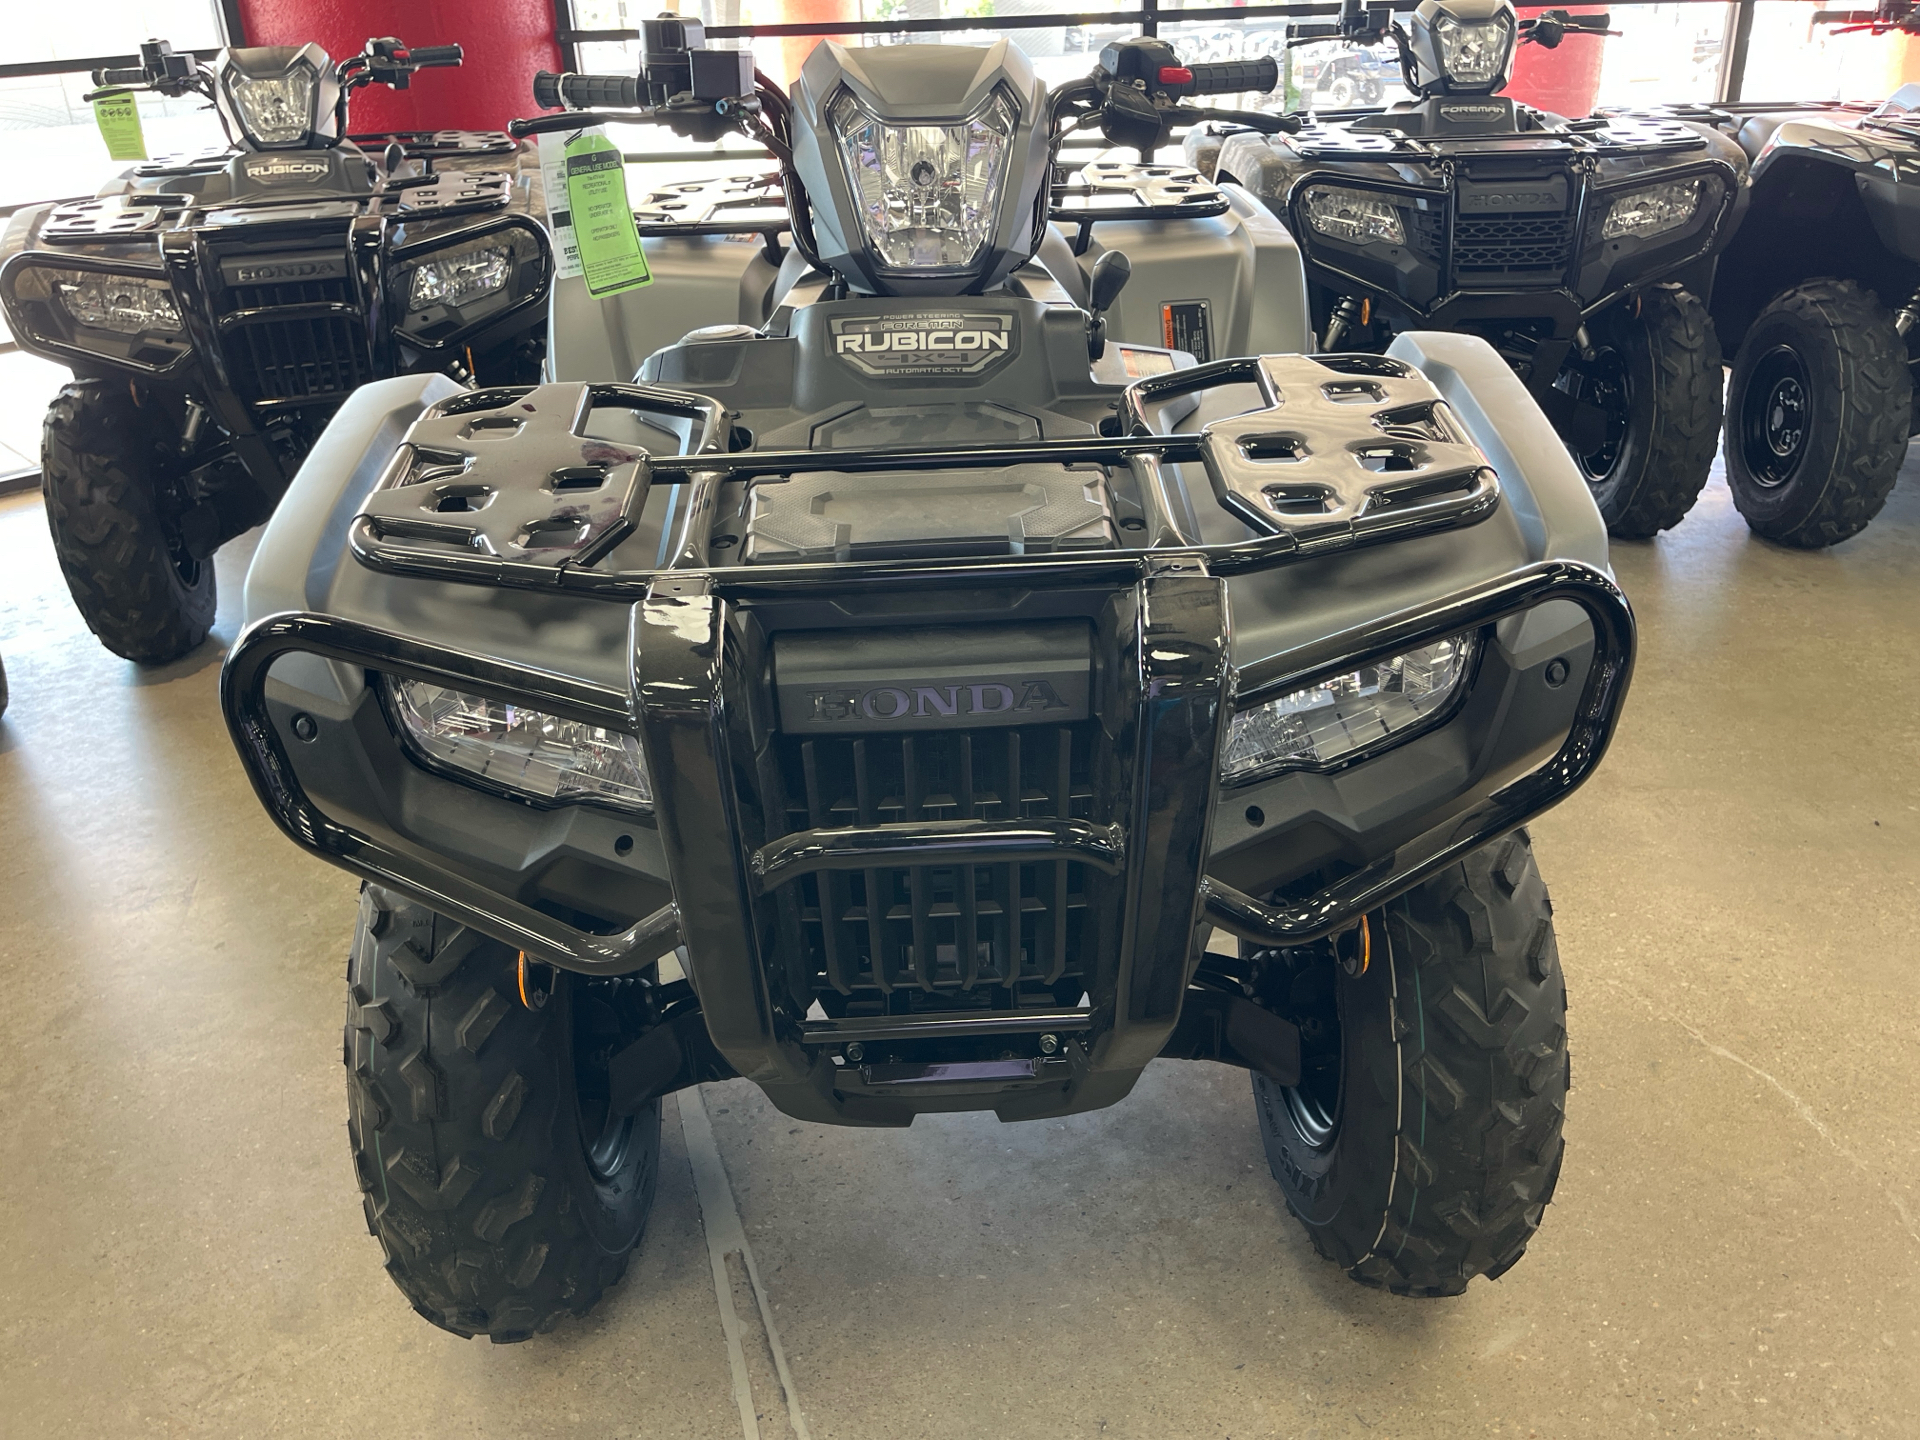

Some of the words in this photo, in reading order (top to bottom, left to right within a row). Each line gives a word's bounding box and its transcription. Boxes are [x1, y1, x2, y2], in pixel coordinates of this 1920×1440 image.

[1440, 106, 1505, 114] FOREMAN
[247, 164, 329, 177] RUBICON
[570, 165, 592, 175] GENERAL
[592, 163, 603, 171] USE
[603, 160, 619, 169] MODEL
[1469, 193, 1558, 206] HONDA
[236, 262, 336, 282] HONDA
[881, 319, 964, 331] FOREMAN
[836, 331, 1009, 354] RUBICON
[877, 353, 969, 363] 4X4
[886, 367, 941, 375] AUTOMATIC
[806, 680, 1070, 723] HONDA
